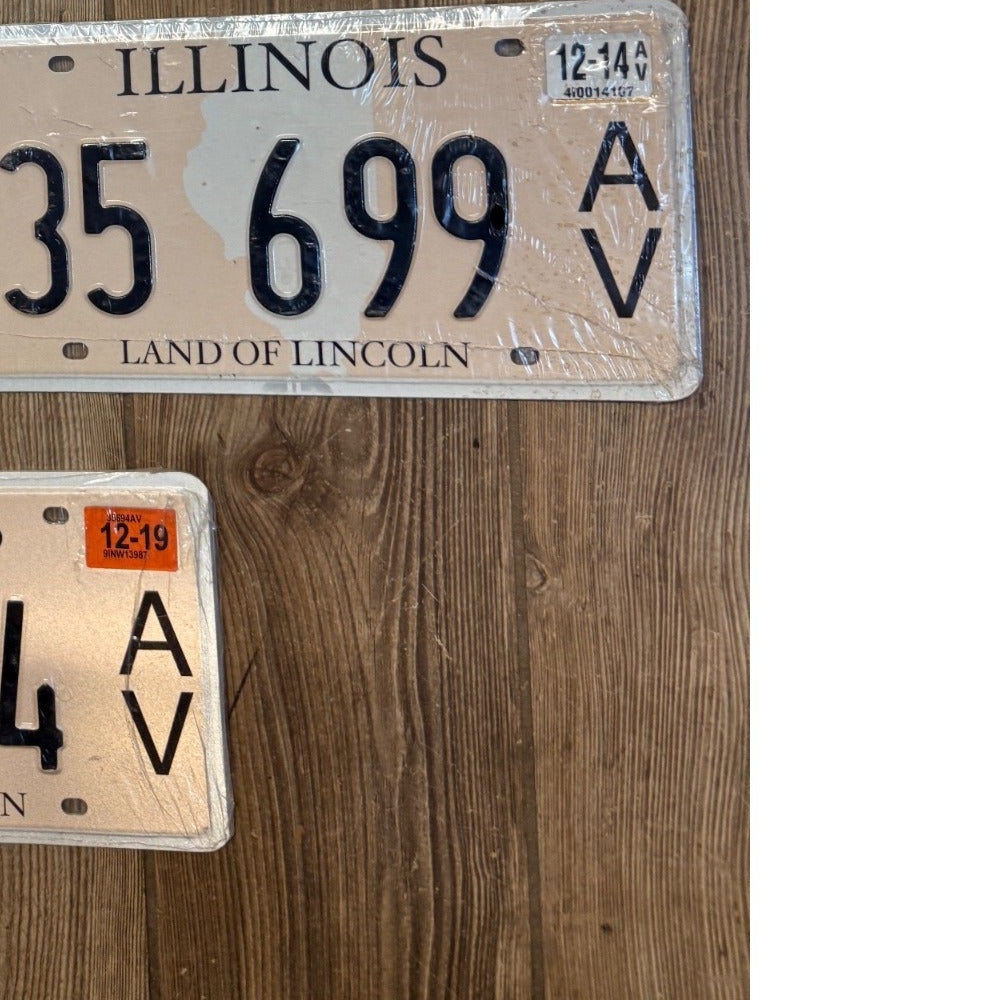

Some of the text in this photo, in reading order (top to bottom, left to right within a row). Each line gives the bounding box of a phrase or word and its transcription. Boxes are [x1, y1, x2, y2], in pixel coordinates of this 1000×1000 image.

[116, 34, 449, 98] ILLINOIS
[556, 41, 630, 81] 12-14
[248, 135, 509, 319] 699
[119, 338, 471, 370] LAND OF LINCOLN
[100, 522, 169, 551] 12-19
